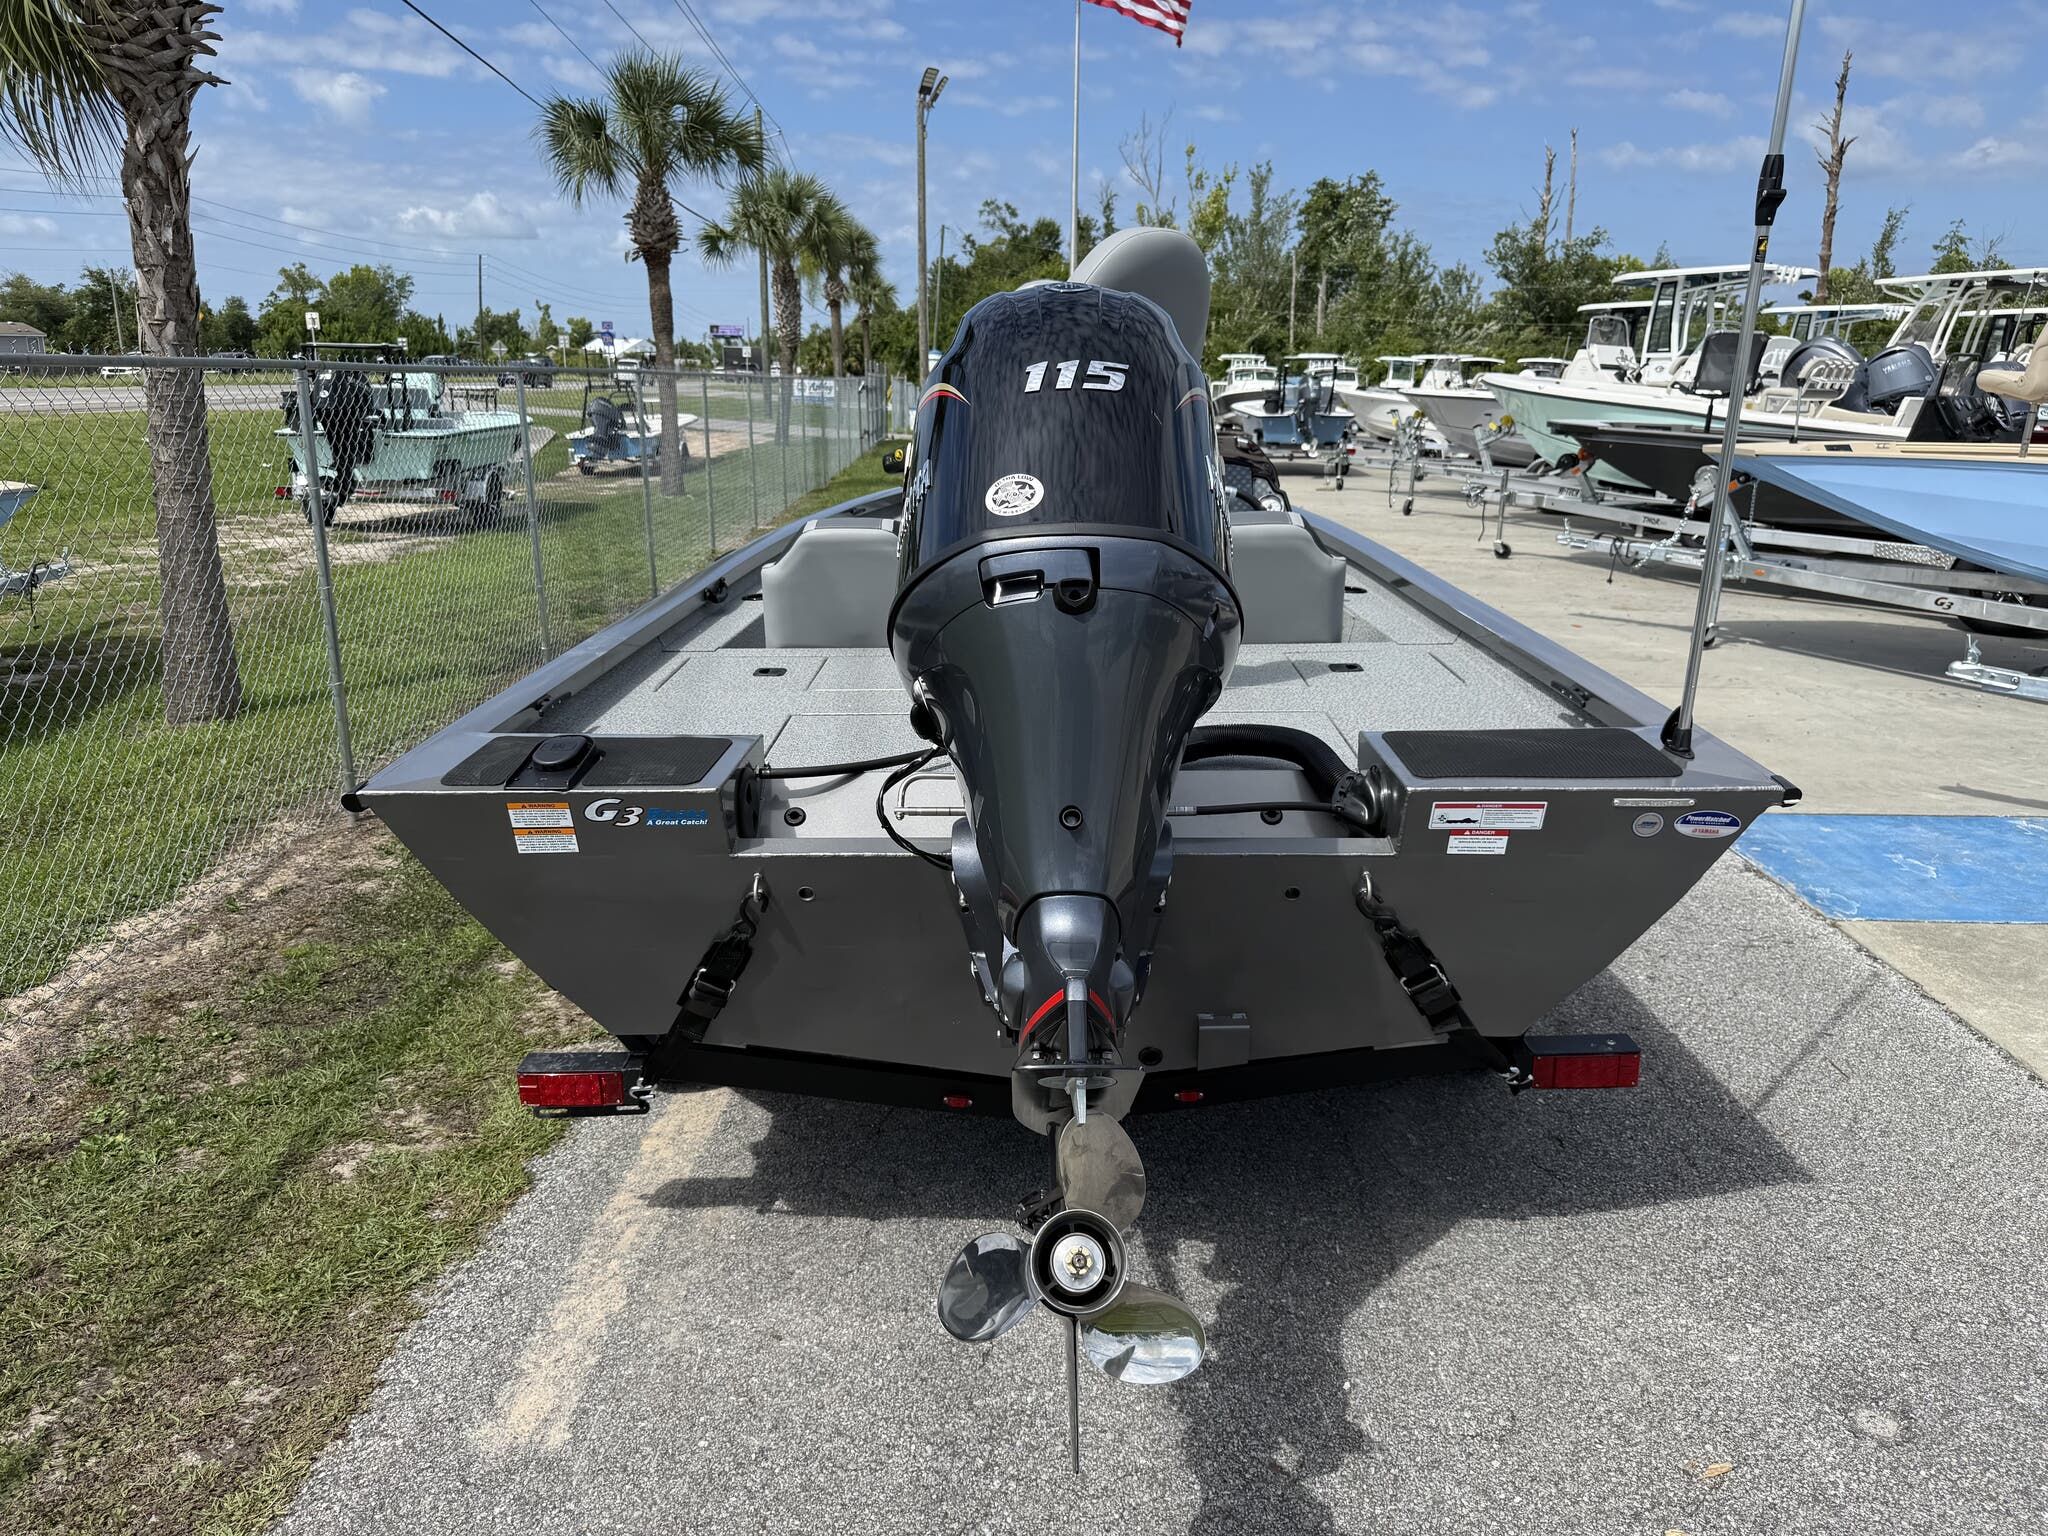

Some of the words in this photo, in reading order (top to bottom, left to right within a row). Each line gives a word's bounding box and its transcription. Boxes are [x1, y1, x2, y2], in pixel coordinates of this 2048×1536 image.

[1024, 359, 1130, 393] 115
[1934, 596, 1954, 610] G3
[583, 797, 644, 828] G3
